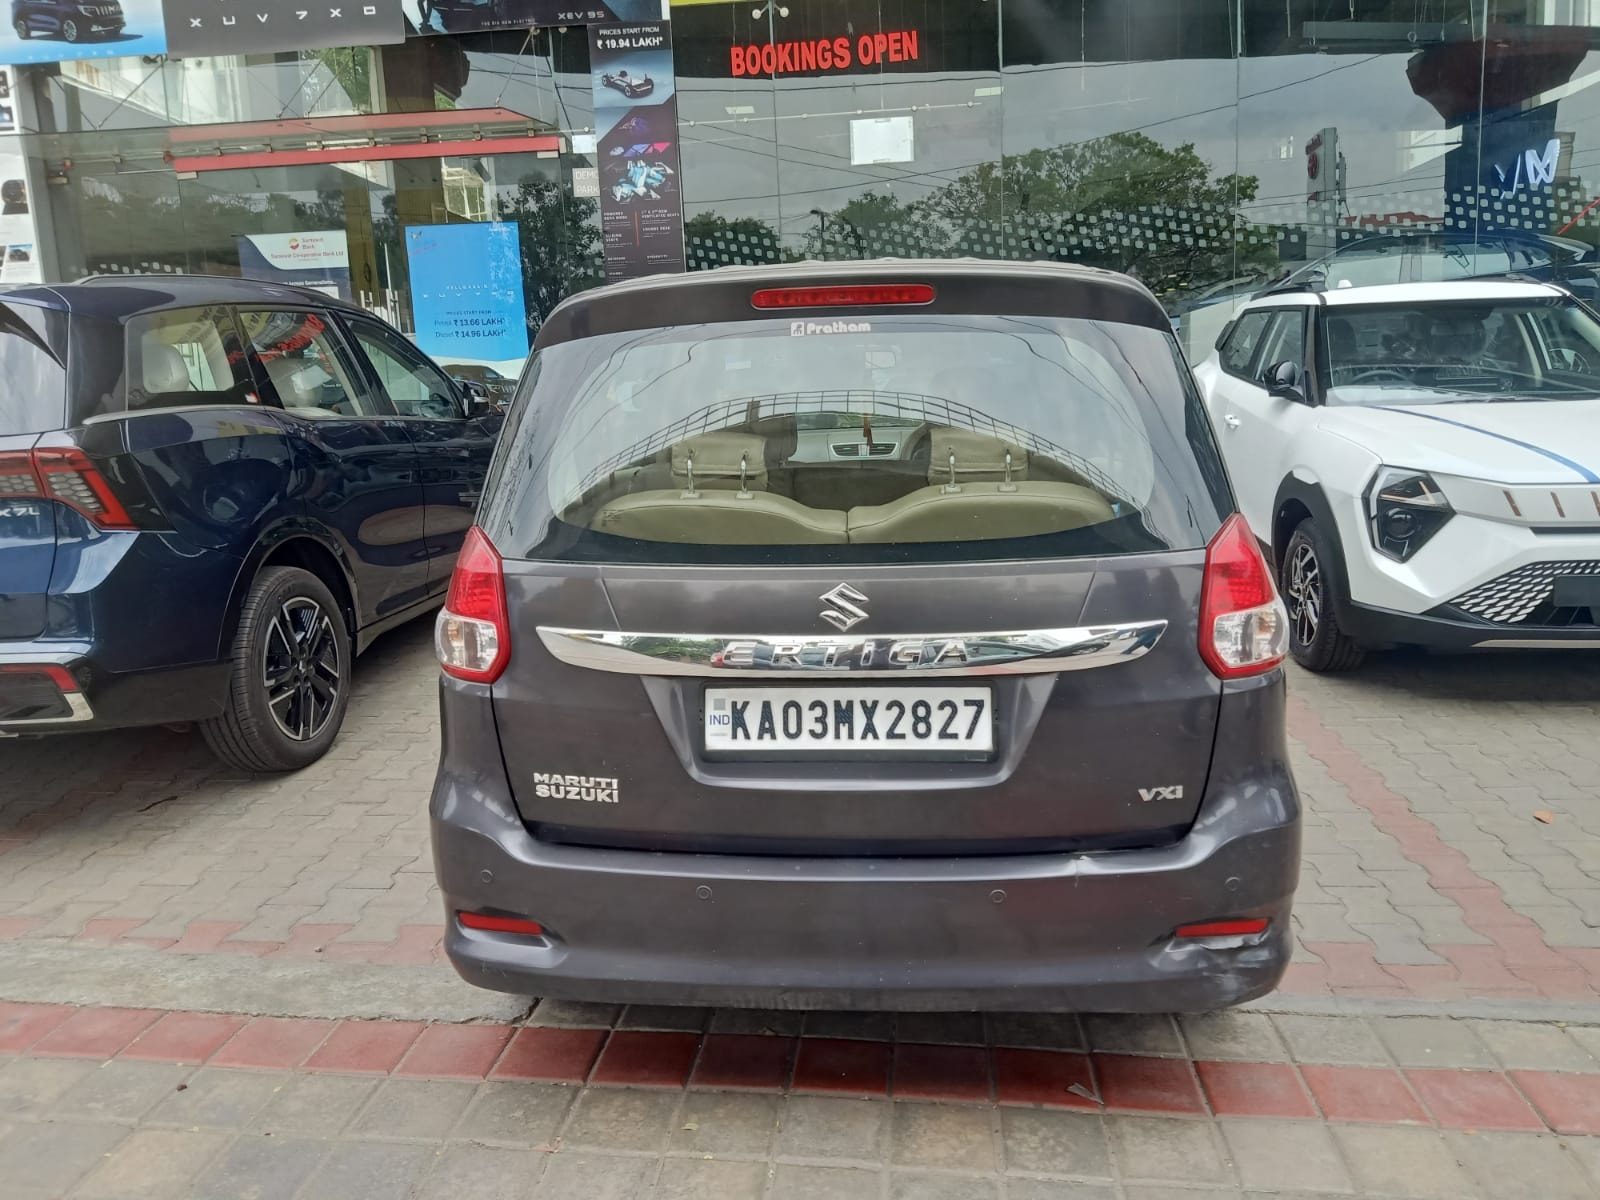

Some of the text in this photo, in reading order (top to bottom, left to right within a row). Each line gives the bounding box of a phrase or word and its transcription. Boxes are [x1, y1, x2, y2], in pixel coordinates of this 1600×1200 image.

[558, 12, 583, 20] XEV
[599, 26, 660, 36] PRICES START FROM
[730, 30, 919, 76] BOOKINGS OPEN
[806, 321, 871, 334] Pratham
[722, 639, 969, 667] ERTIGA
[709, 699, 985, 741] IND KA03MX2827
[533, 772, 618, 789] MARUTI
[535, 784, 619, 803] SUZUKI
[1137, 785, 1184, 802] VXI
